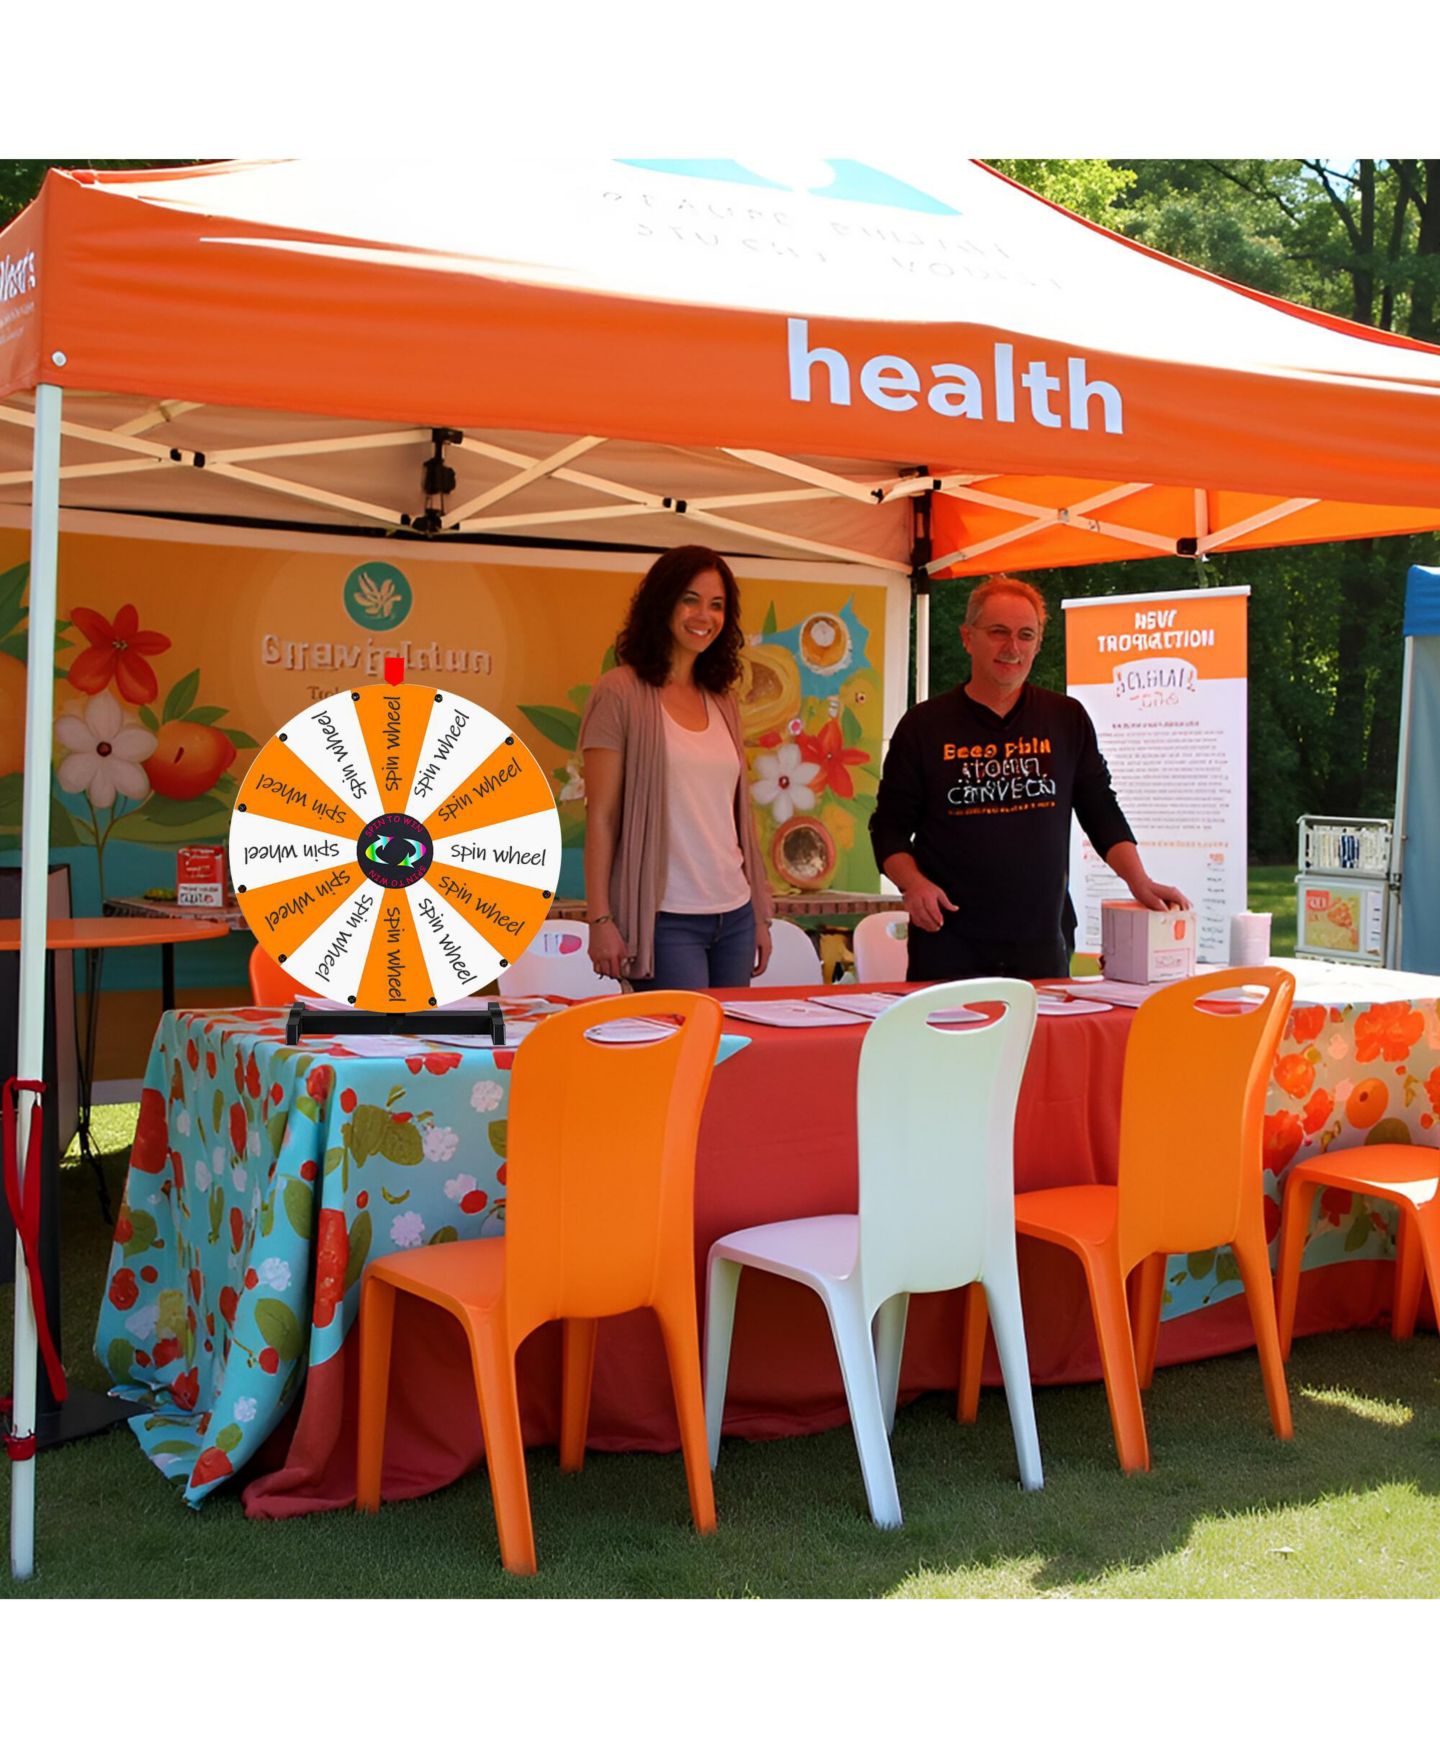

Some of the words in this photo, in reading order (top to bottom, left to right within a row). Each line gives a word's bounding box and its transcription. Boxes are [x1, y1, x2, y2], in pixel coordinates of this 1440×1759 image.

[787, 318, 1123, 435] health
[312, 711, 348, 762] wheel
[384, 697, 400, 749] wheel
[415, 764, 440, 797] spin
[434, 709, 469, 760] wheel
[257, 775, 306, 806] wheel
[343, 764, 366, 799] spin
[386, 757, 401, 791] spin
[439, 795, 472, 821] spin
[473, 758, 521, 797] wheel
[312, 800, 345, 822] spin
[365, 818, 386, 837] SPIN
[387, 815, 401, 823] TO
[403, 816, 424, 833] WIN
[245, 845, 297, 864] wheel
[304, 840, 339, 862] spin
[451, 845, 486, 862] spin
[493, 846, 546, 866] wheel
[316, 871, 350, 896] spin
[368, 869, 389, 887] WIN
[405, 865, 426, 884] SPIN
[265, 892, 315, 931] wheel
[347, 895, 373, 927] spin
[439, 877, 471, 903] spin
[476, 898, 524, 935] wheel
[384, 908, 400, 942] spin
[419, 899, 443, 932] spin
[439, 934, 477, 984] wheel
[315, 932, 352, 982] wheel
[388, 950, 405, 1001] wheel
